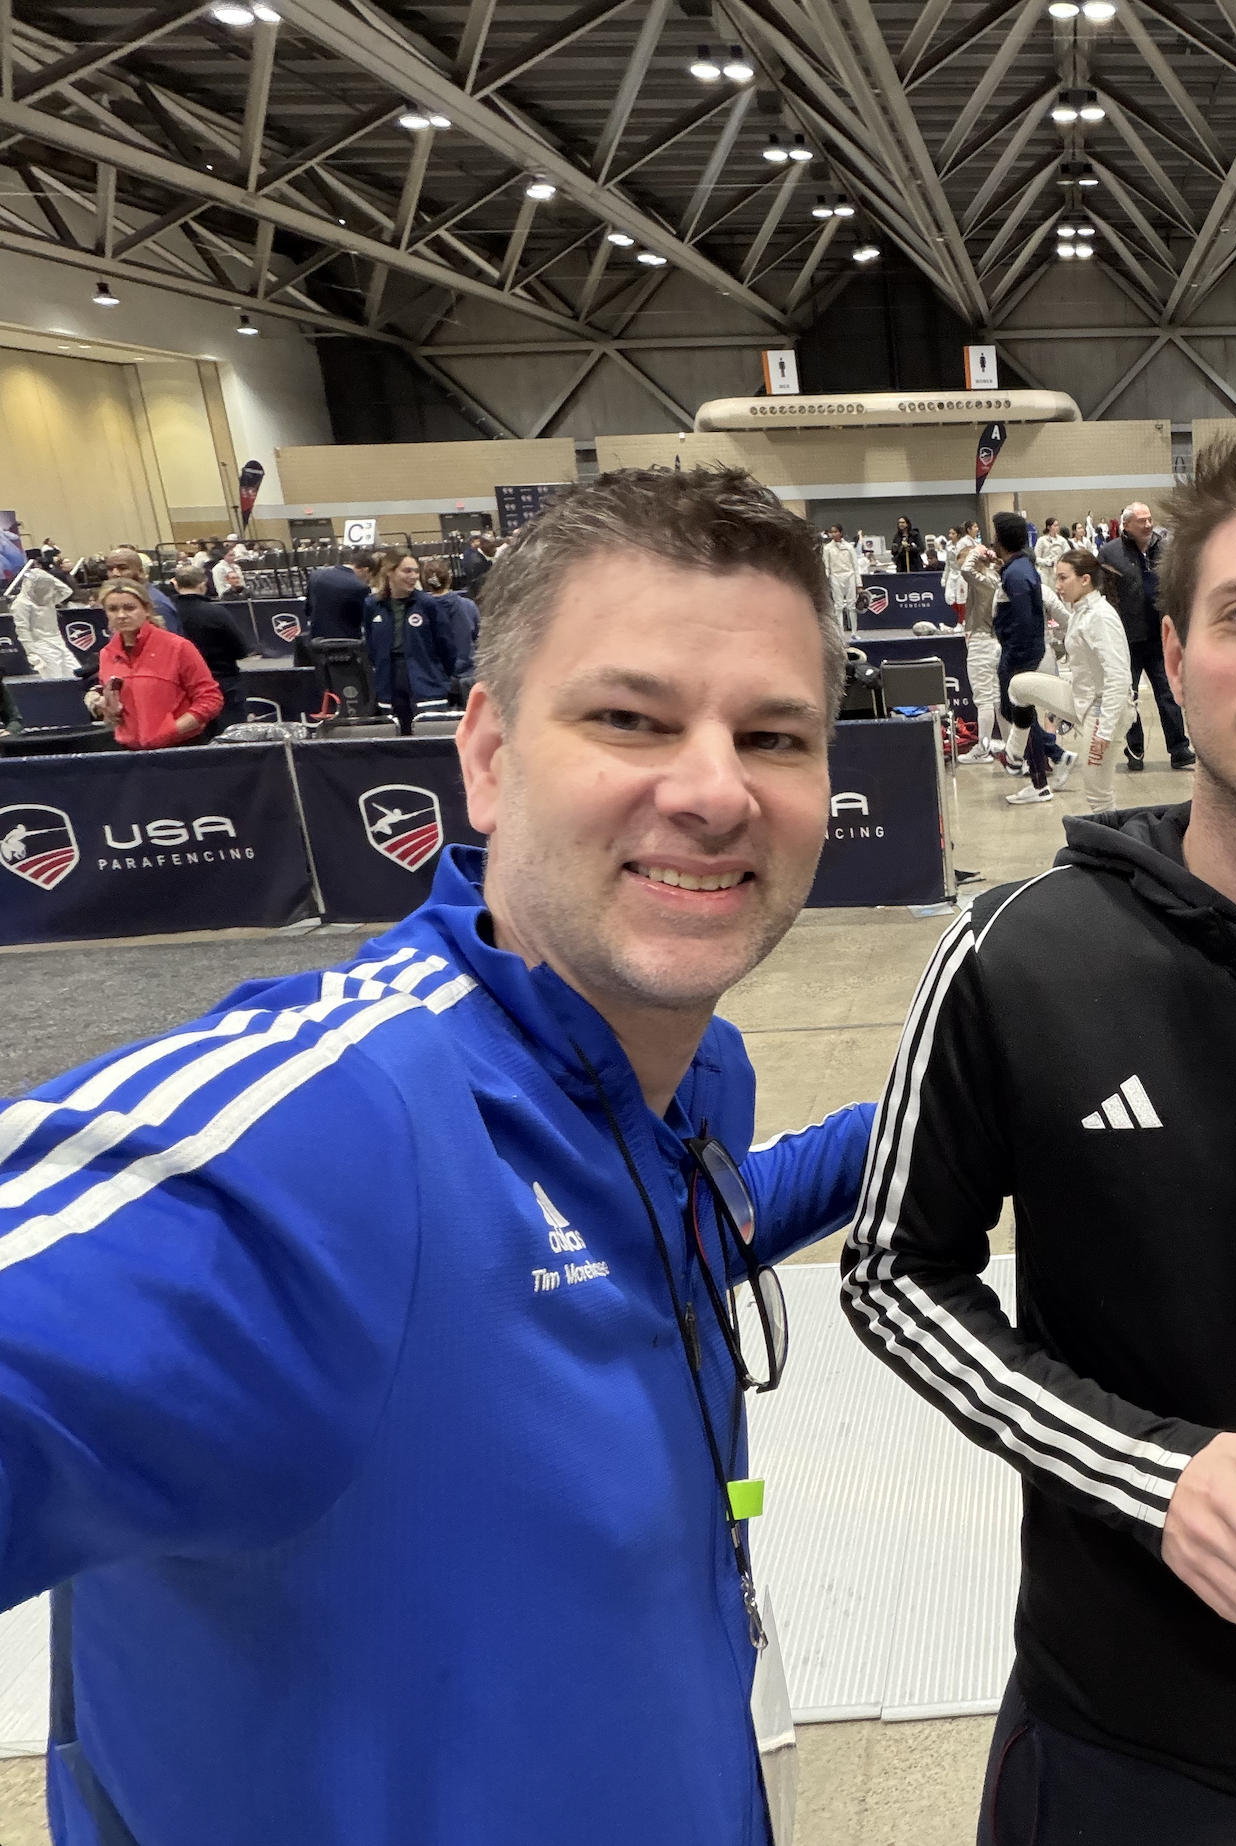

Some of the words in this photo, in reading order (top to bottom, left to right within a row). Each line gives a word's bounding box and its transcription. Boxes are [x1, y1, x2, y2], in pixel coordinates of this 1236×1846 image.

[991, 425, 1000, 440] A
[348, 523, 363, 543] C
[895, 592, 934, 602] USA
[103, 815, 237, 850] USA
[98, 847, 255, 871] PARAFENCING
[531, 1268, 561, 1293] Tim
